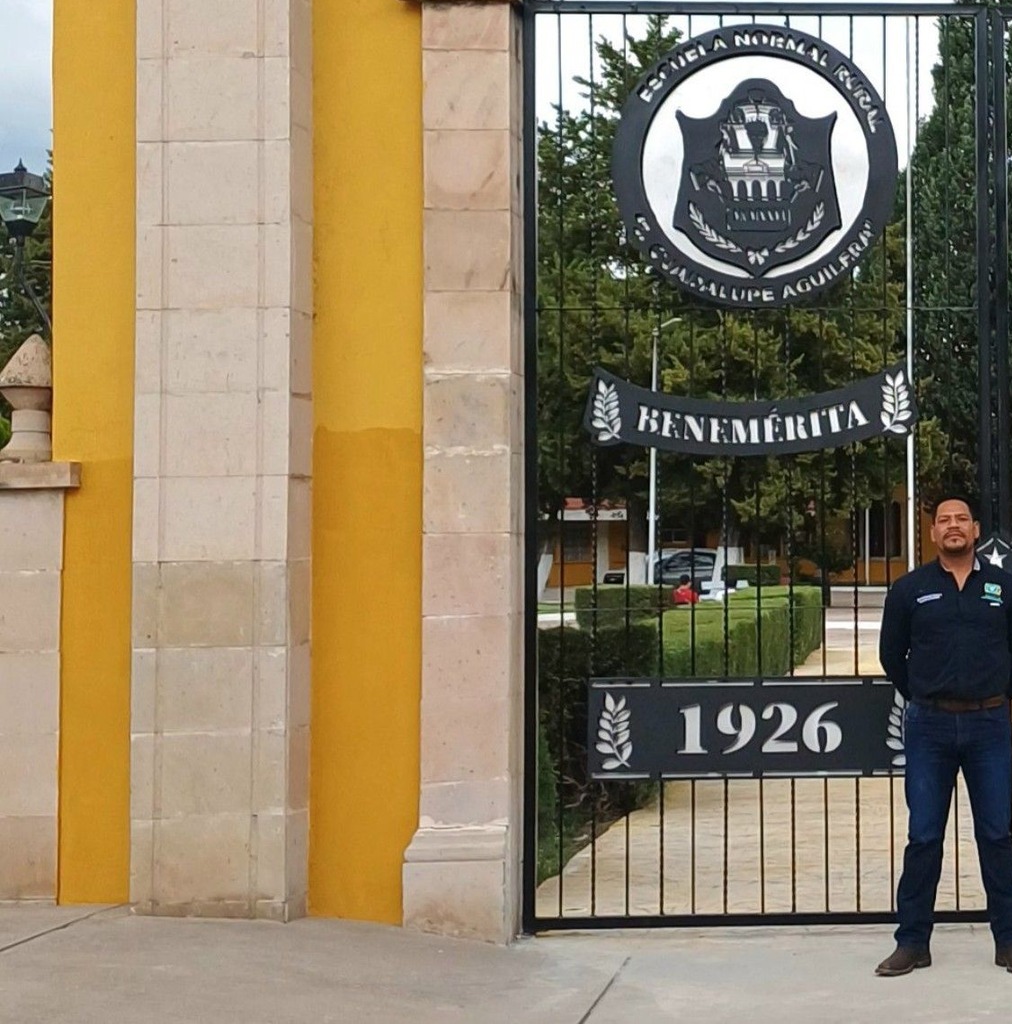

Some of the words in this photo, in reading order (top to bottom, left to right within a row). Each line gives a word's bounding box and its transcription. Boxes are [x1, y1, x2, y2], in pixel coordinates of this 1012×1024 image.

[733, 29, 829, 67] NORMAL
[833, 62, 884, 134] RURAL
[637, 399, 870, 444] BENEMÉRITA
[677, 701, 843, 754] 1926
